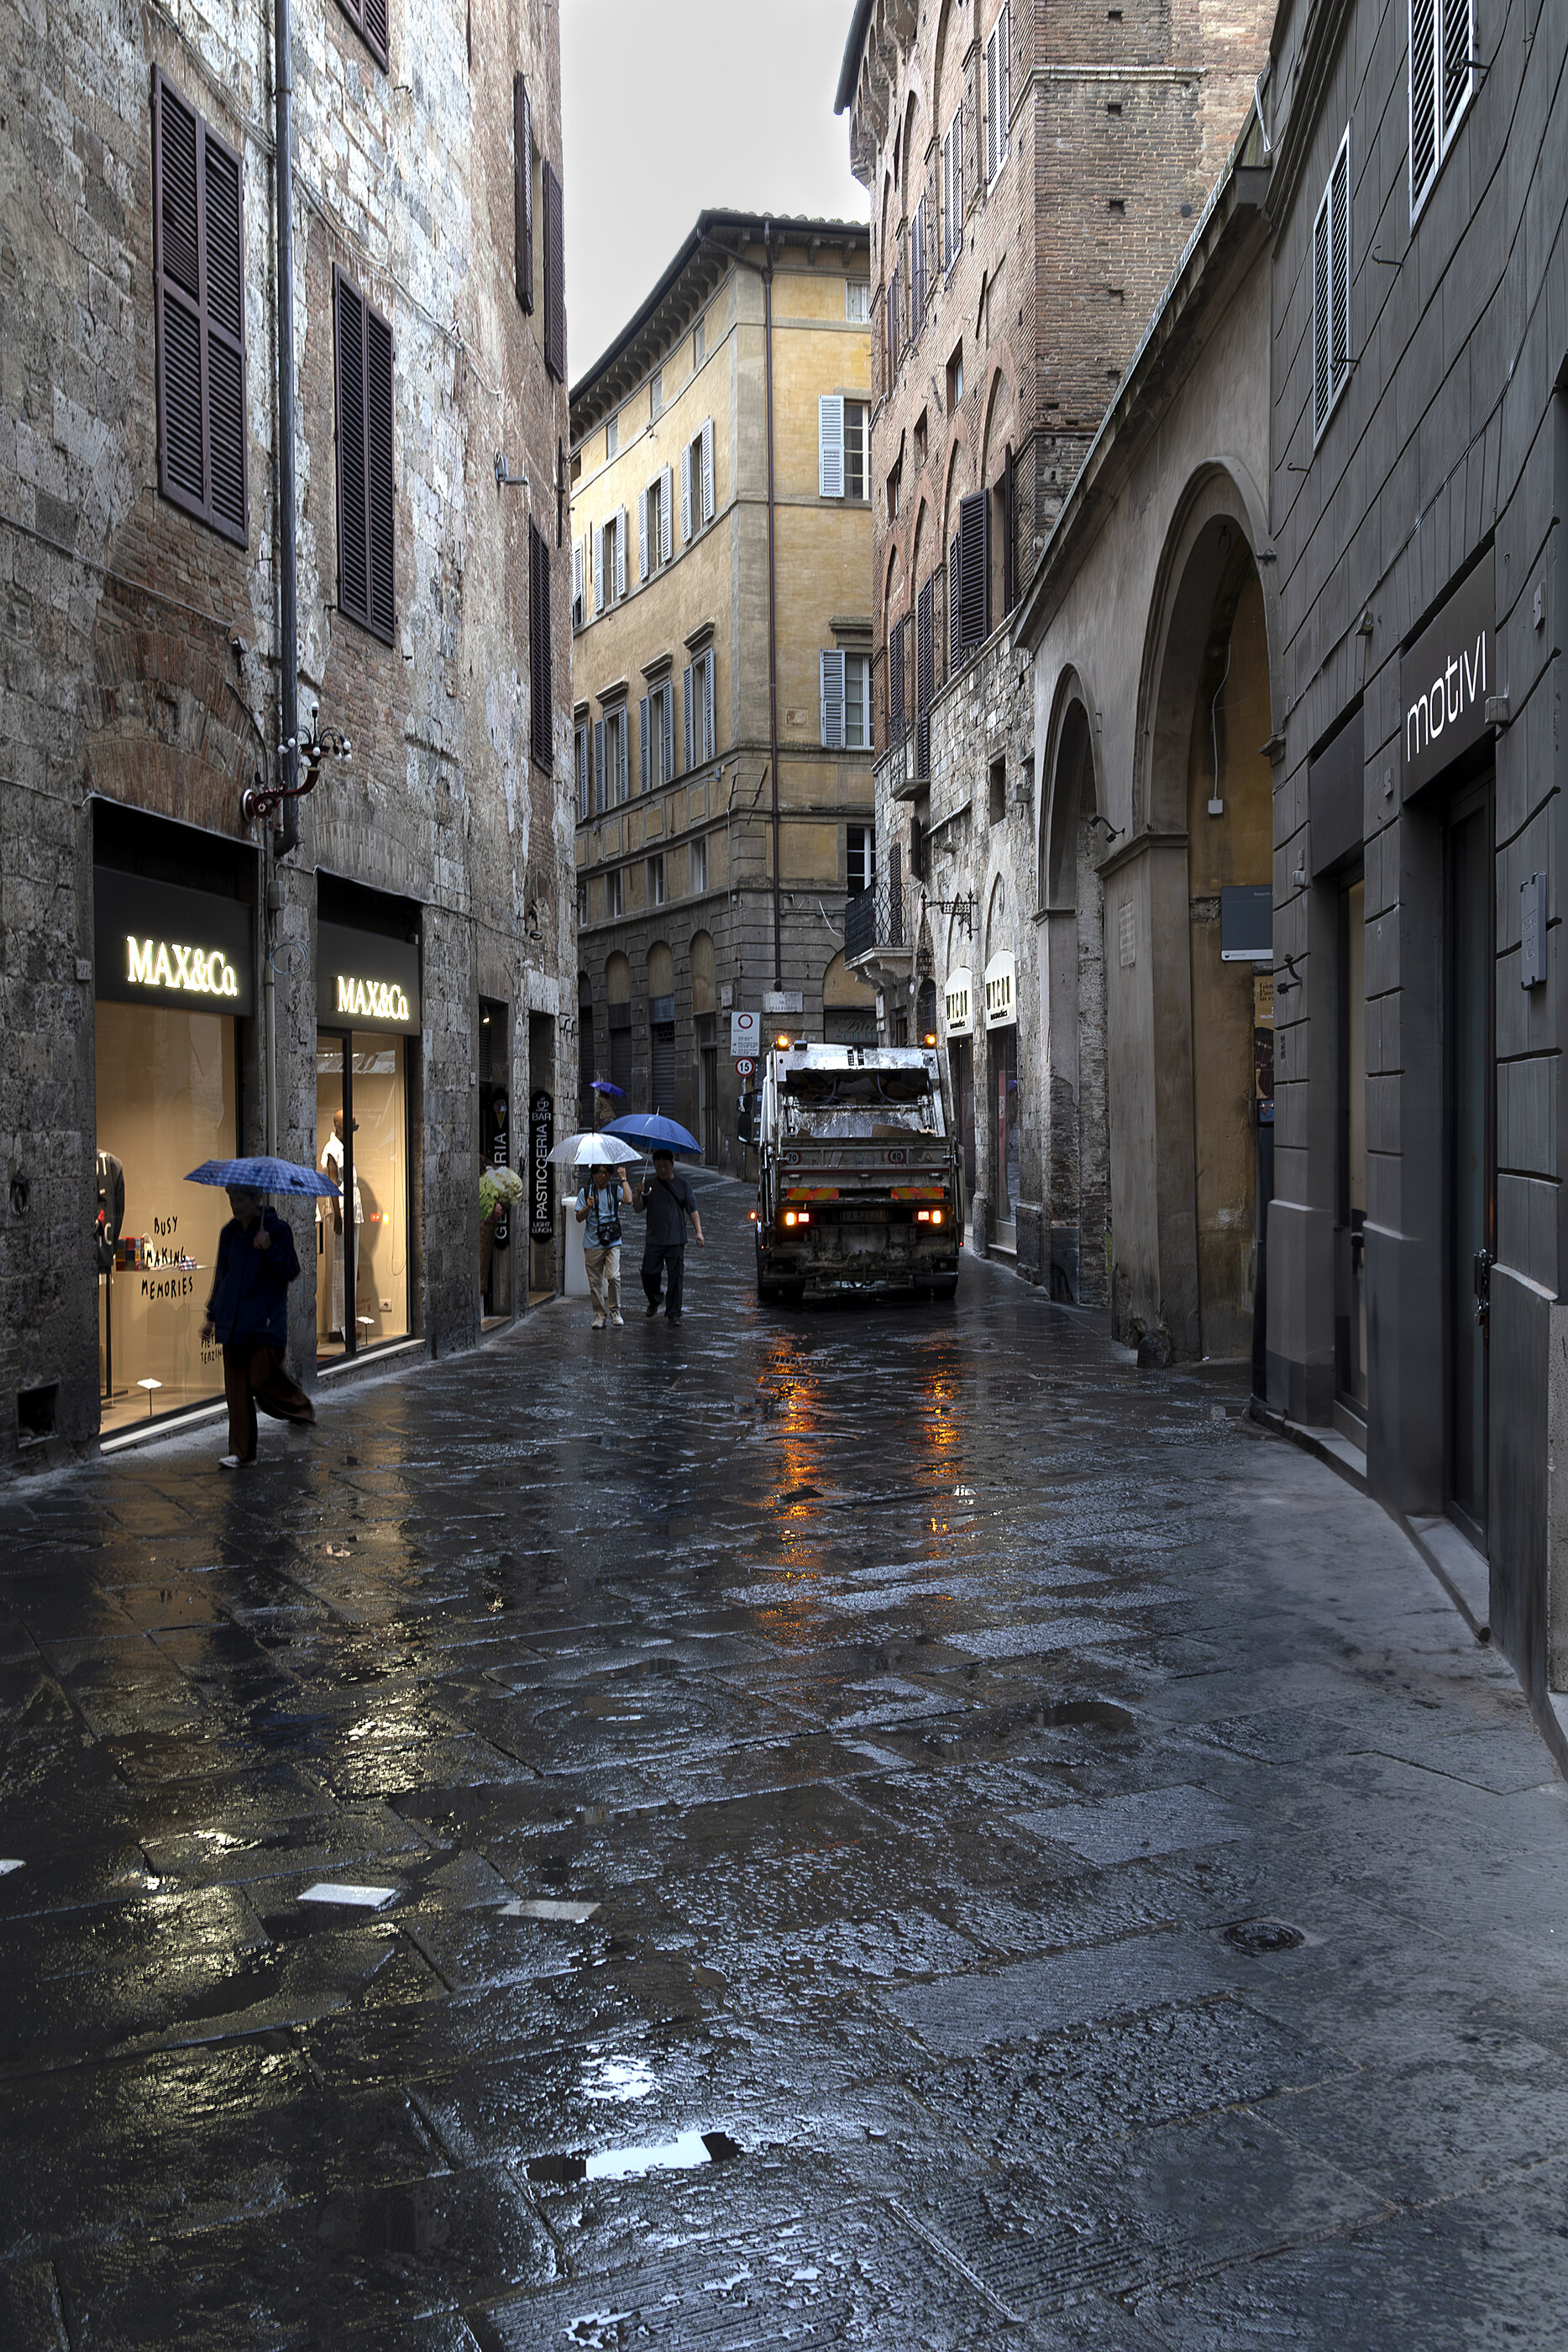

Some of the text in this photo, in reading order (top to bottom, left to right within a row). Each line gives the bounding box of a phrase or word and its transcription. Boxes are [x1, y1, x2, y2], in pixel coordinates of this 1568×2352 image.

[126, 935, 239, 997] MAX&Co.
[337, 974, 410, 1021] MAX&Co.
[740, 1062, 750, 1072] 15
[532, 1111, 552, 1121] BAR
[789, 1153, 798, 1163] 70
[536, 1123, 548, 1220] PASTICCERIA
[154, 1215, 178, 1236] BUSY
[146, 1245, 186, 1267] MAKING
[141, 1275, 193, 1300] MEMORIES
